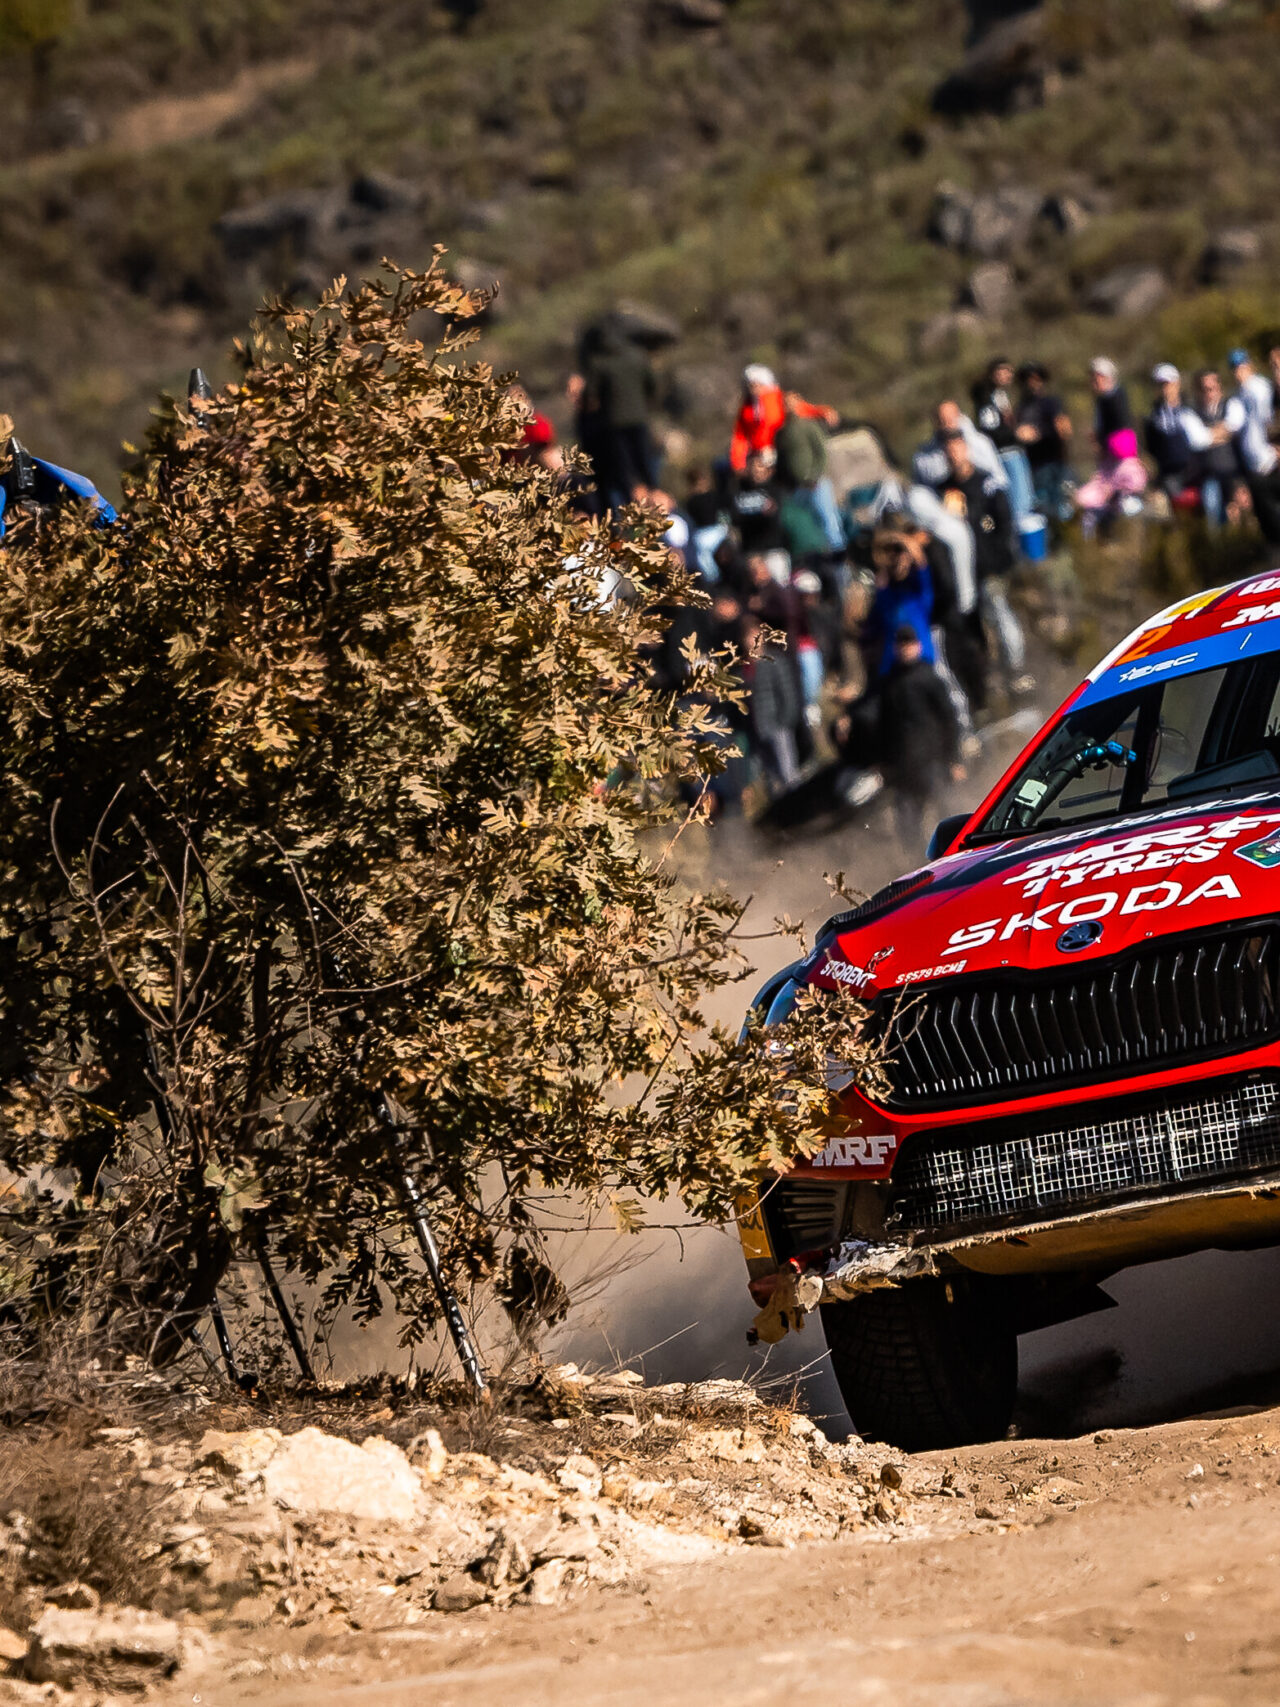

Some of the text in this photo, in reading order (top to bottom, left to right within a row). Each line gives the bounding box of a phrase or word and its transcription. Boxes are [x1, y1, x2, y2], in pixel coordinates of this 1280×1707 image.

[1115, 625, 1172, 666] 2
[1022, 842, 1227, 898] TYRES
[940, 875, 1242, 956] SKODA
[820, 960, 877, 988] STORENT
[812, 1134, 897, 1167] MRF
